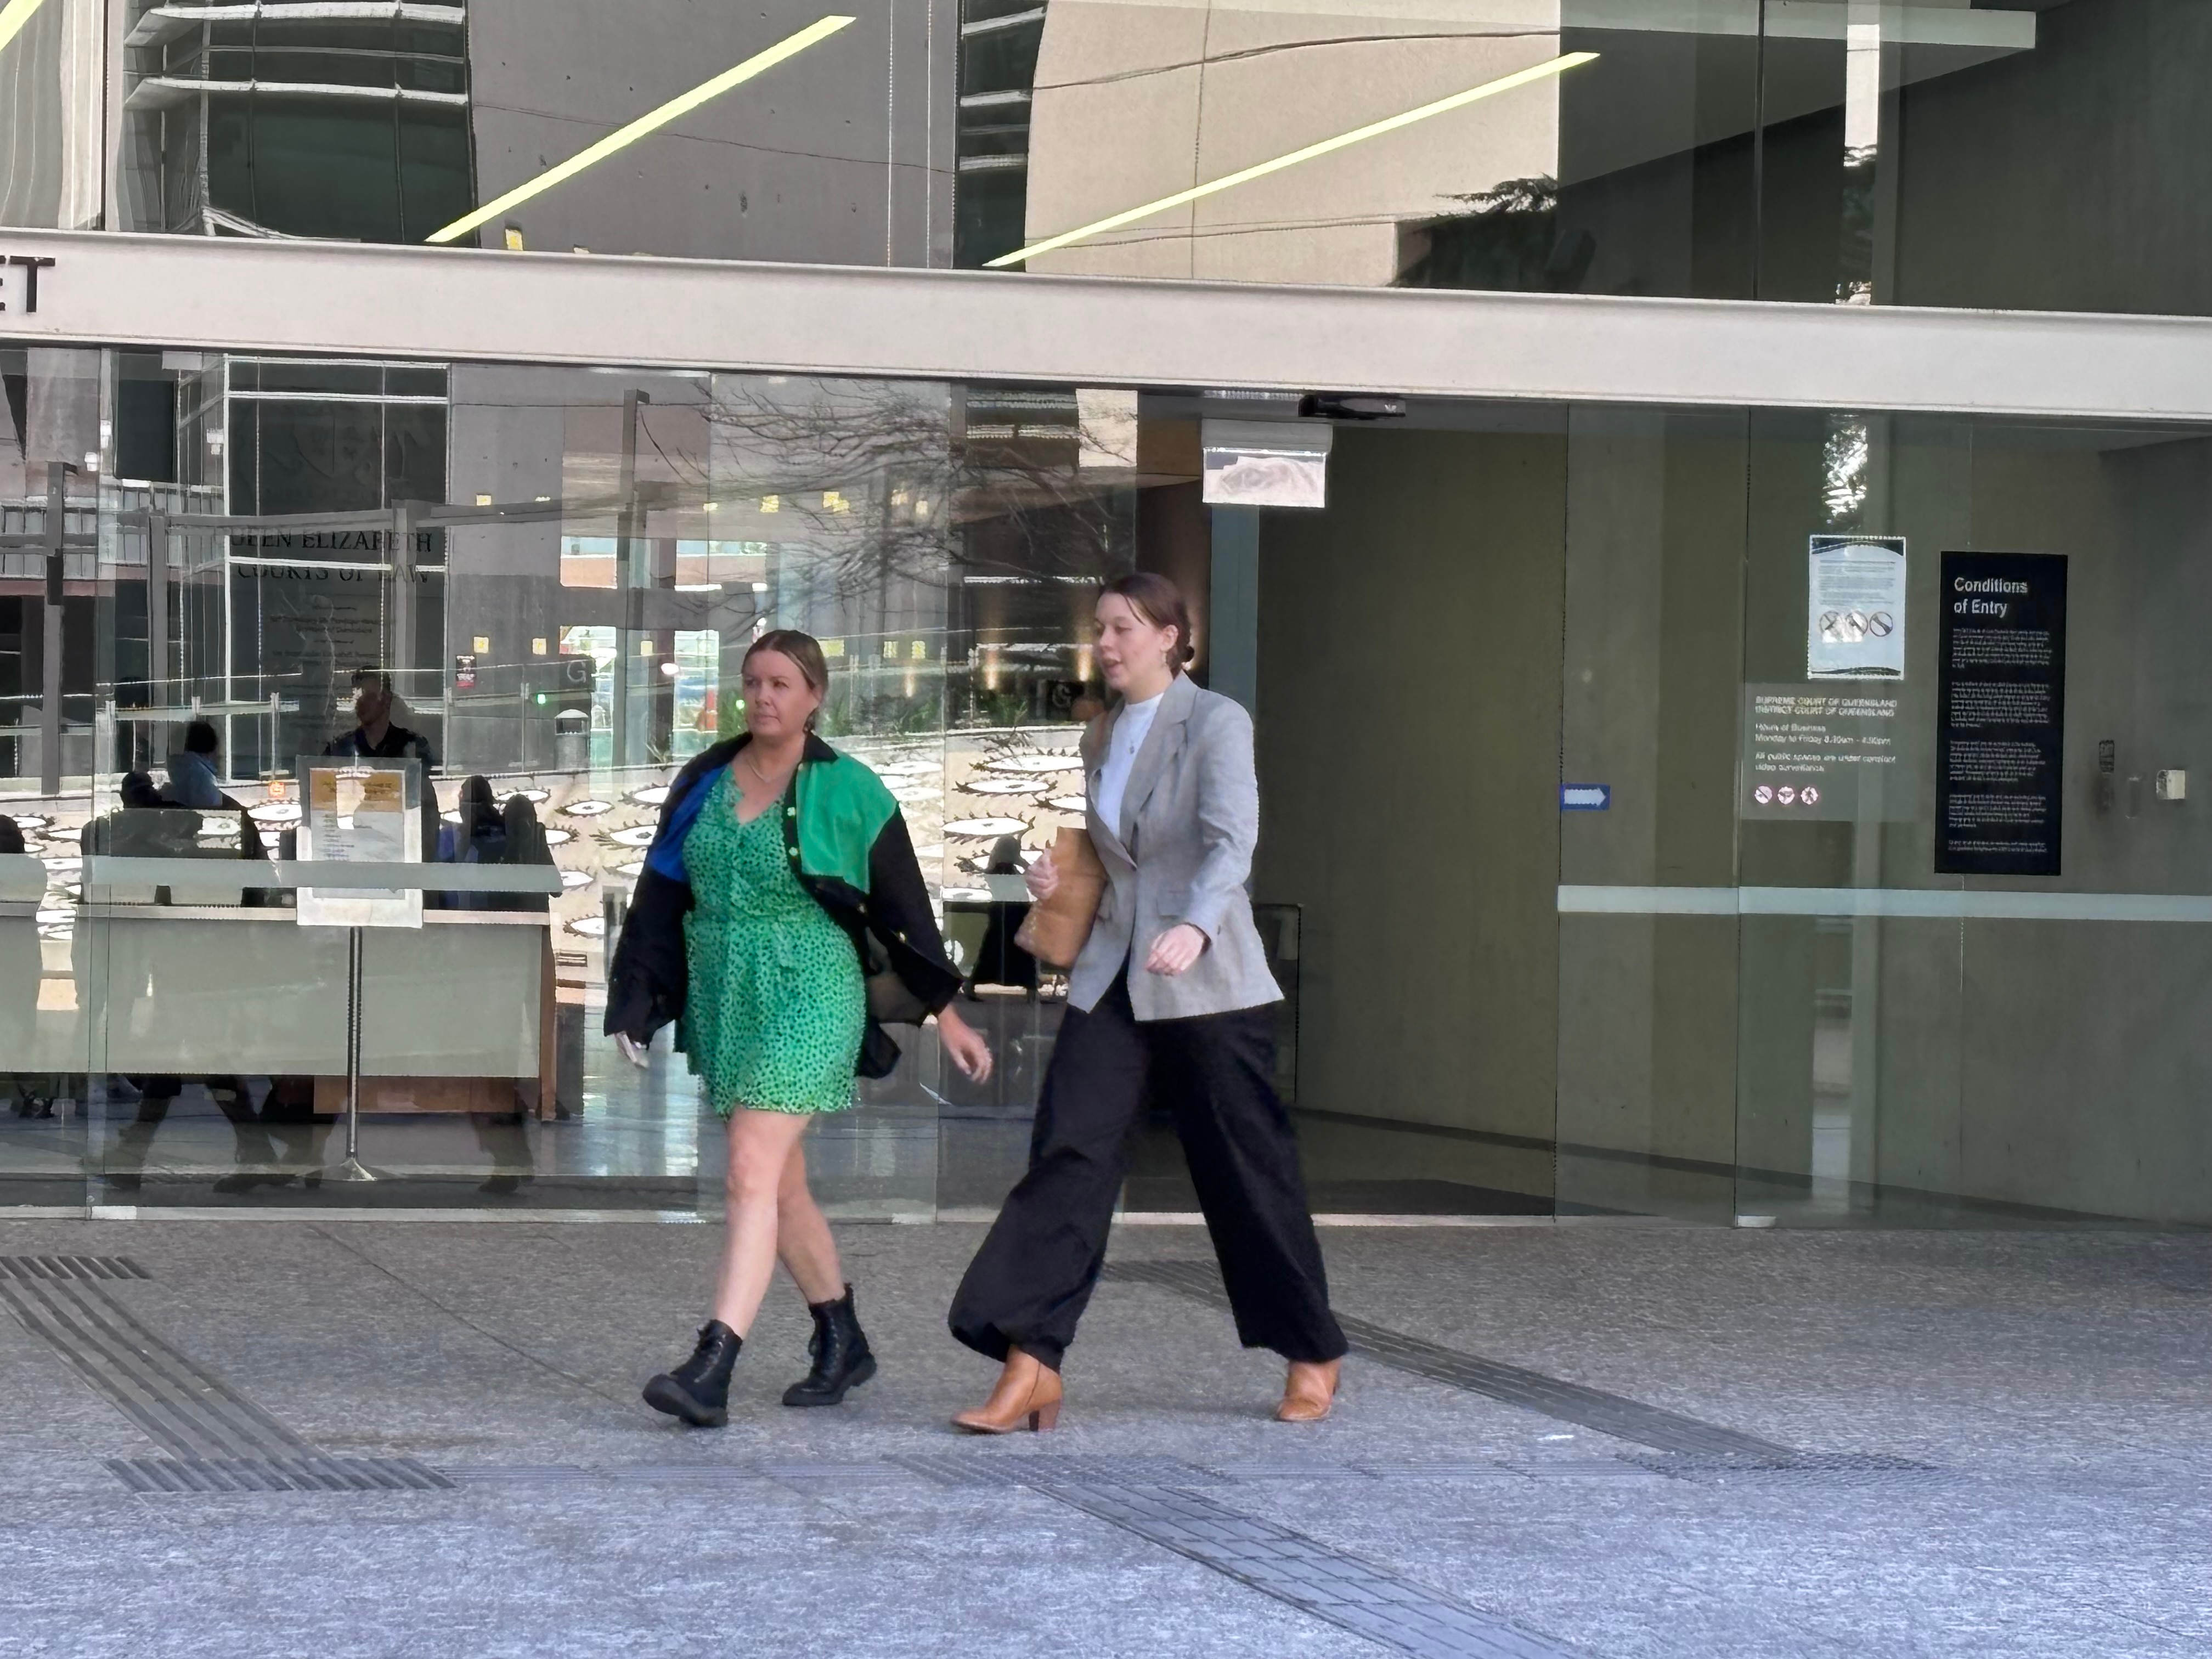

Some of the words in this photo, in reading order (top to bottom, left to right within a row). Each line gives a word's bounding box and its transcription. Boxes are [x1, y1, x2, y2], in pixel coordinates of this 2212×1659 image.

[1954, 577, 2029, 593] Conditions
[1954, 599, 1968, 614] of
[1972, 599, 2007, 618] Entry
[1828, 698, 1839, 706] OF
[1842, 698, 1897, 708] QUEENSLAND
[1838, 707, 1894, 716] QUEENSLAND
[1755, 733, 1787, 743] Monday
[1799, 735, 1821, 744] Friday
[1768, 752, 1791, 761] public
